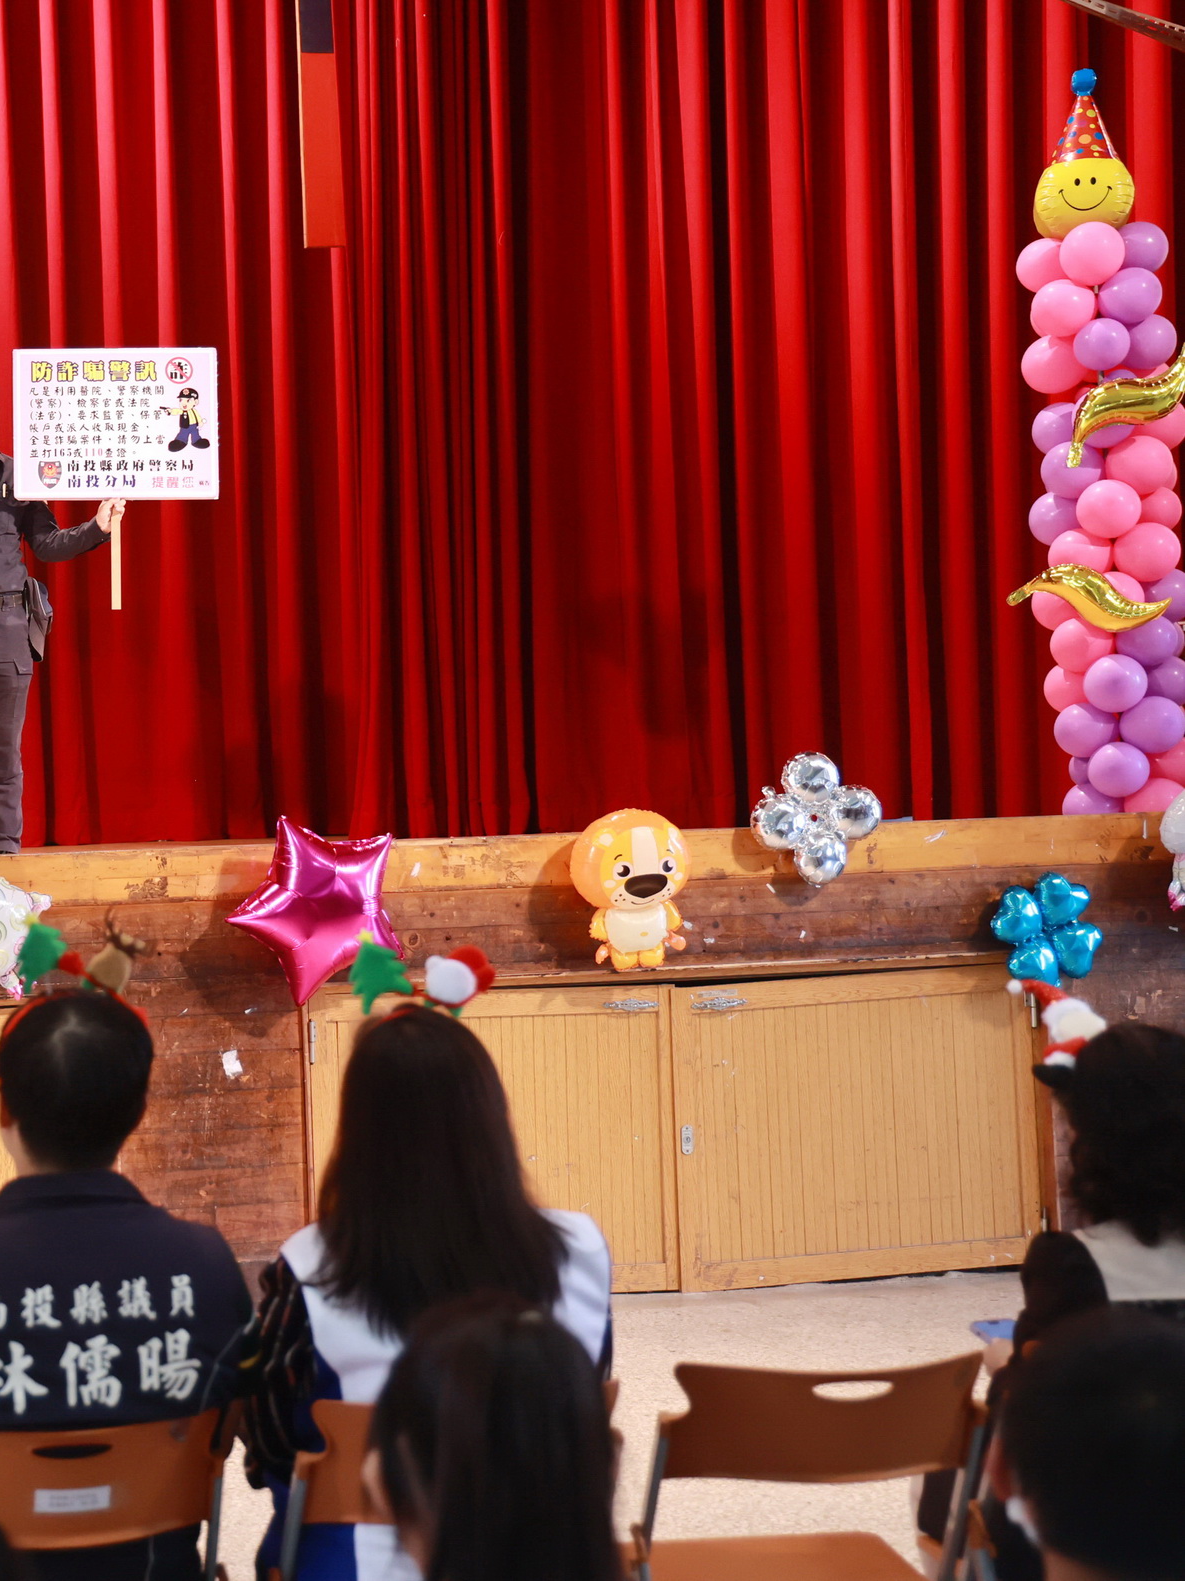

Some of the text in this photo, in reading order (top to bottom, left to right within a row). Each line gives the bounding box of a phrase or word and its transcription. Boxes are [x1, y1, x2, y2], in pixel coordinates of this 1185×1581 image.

[31, 360, 157, 382] 防詐騙警訊
[68, 475, 136, 488] 南投分局
